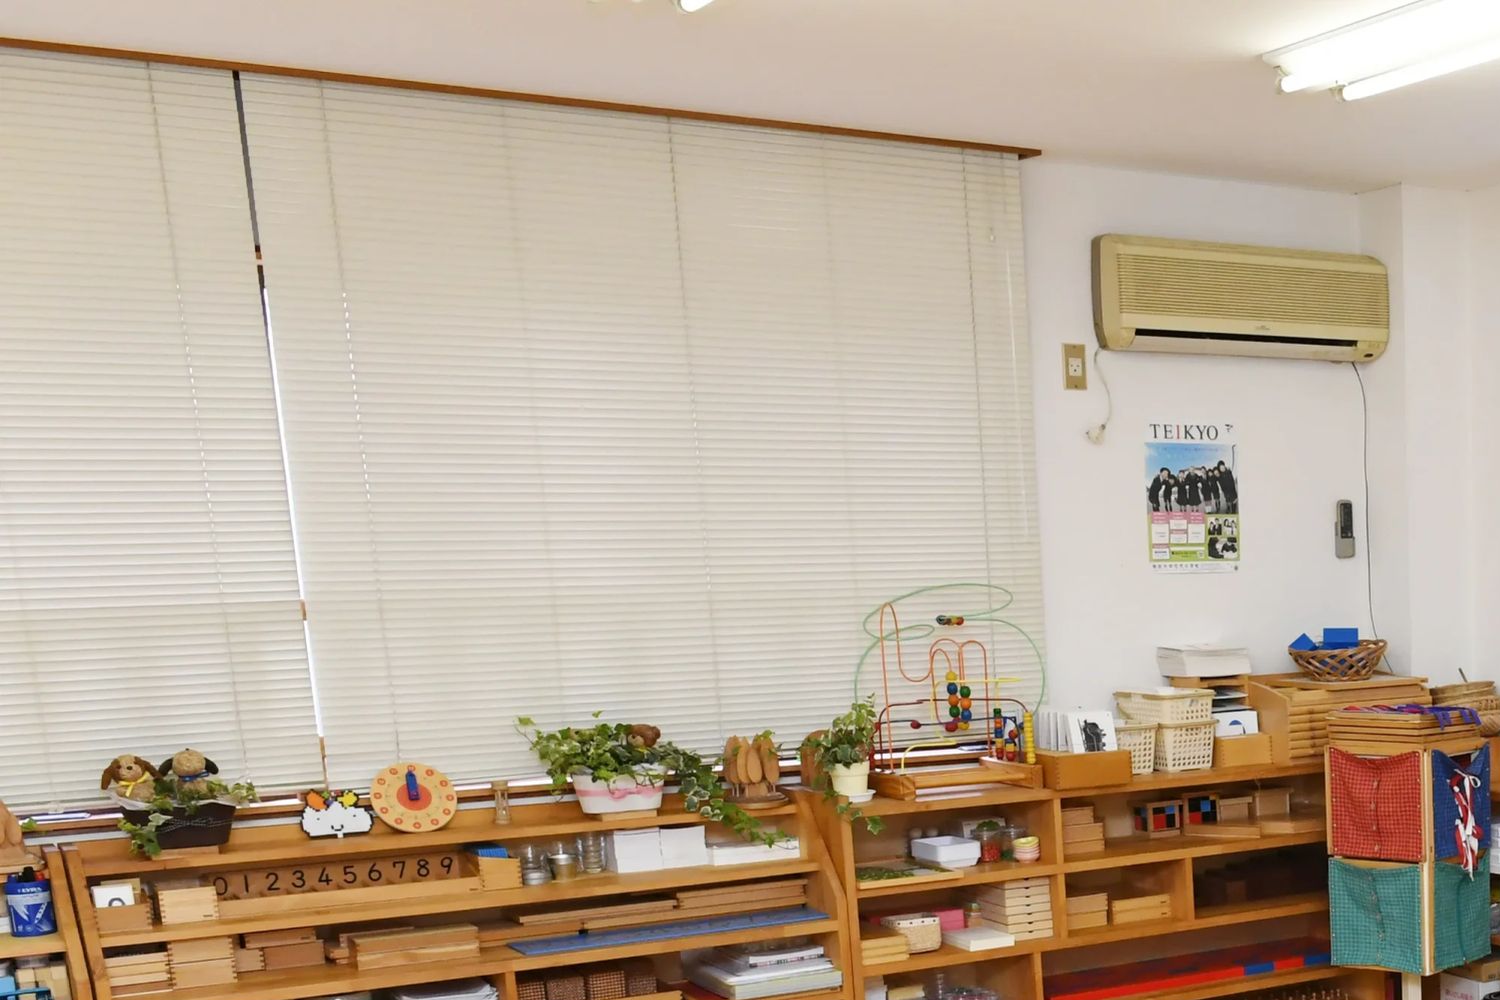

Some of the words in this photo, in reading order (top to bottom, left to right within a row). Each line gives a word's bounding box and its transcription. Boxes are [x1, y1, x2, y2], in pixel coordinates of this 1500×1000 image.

[1149, 423, 1219, 441] TEIKYO
[243, 875, 249, 893] 1
[265, 872, 281, 891] 2
[291, 870, 306, 889] 3
[318, 867, 332, 886] 4
[343, 865, 358, 884] 5
[368, 863, 382, 882] 6
[392, 861, 406, 879] 7
[416, 859, 430, 878] 8
[440, 856, 454, 875] 9
